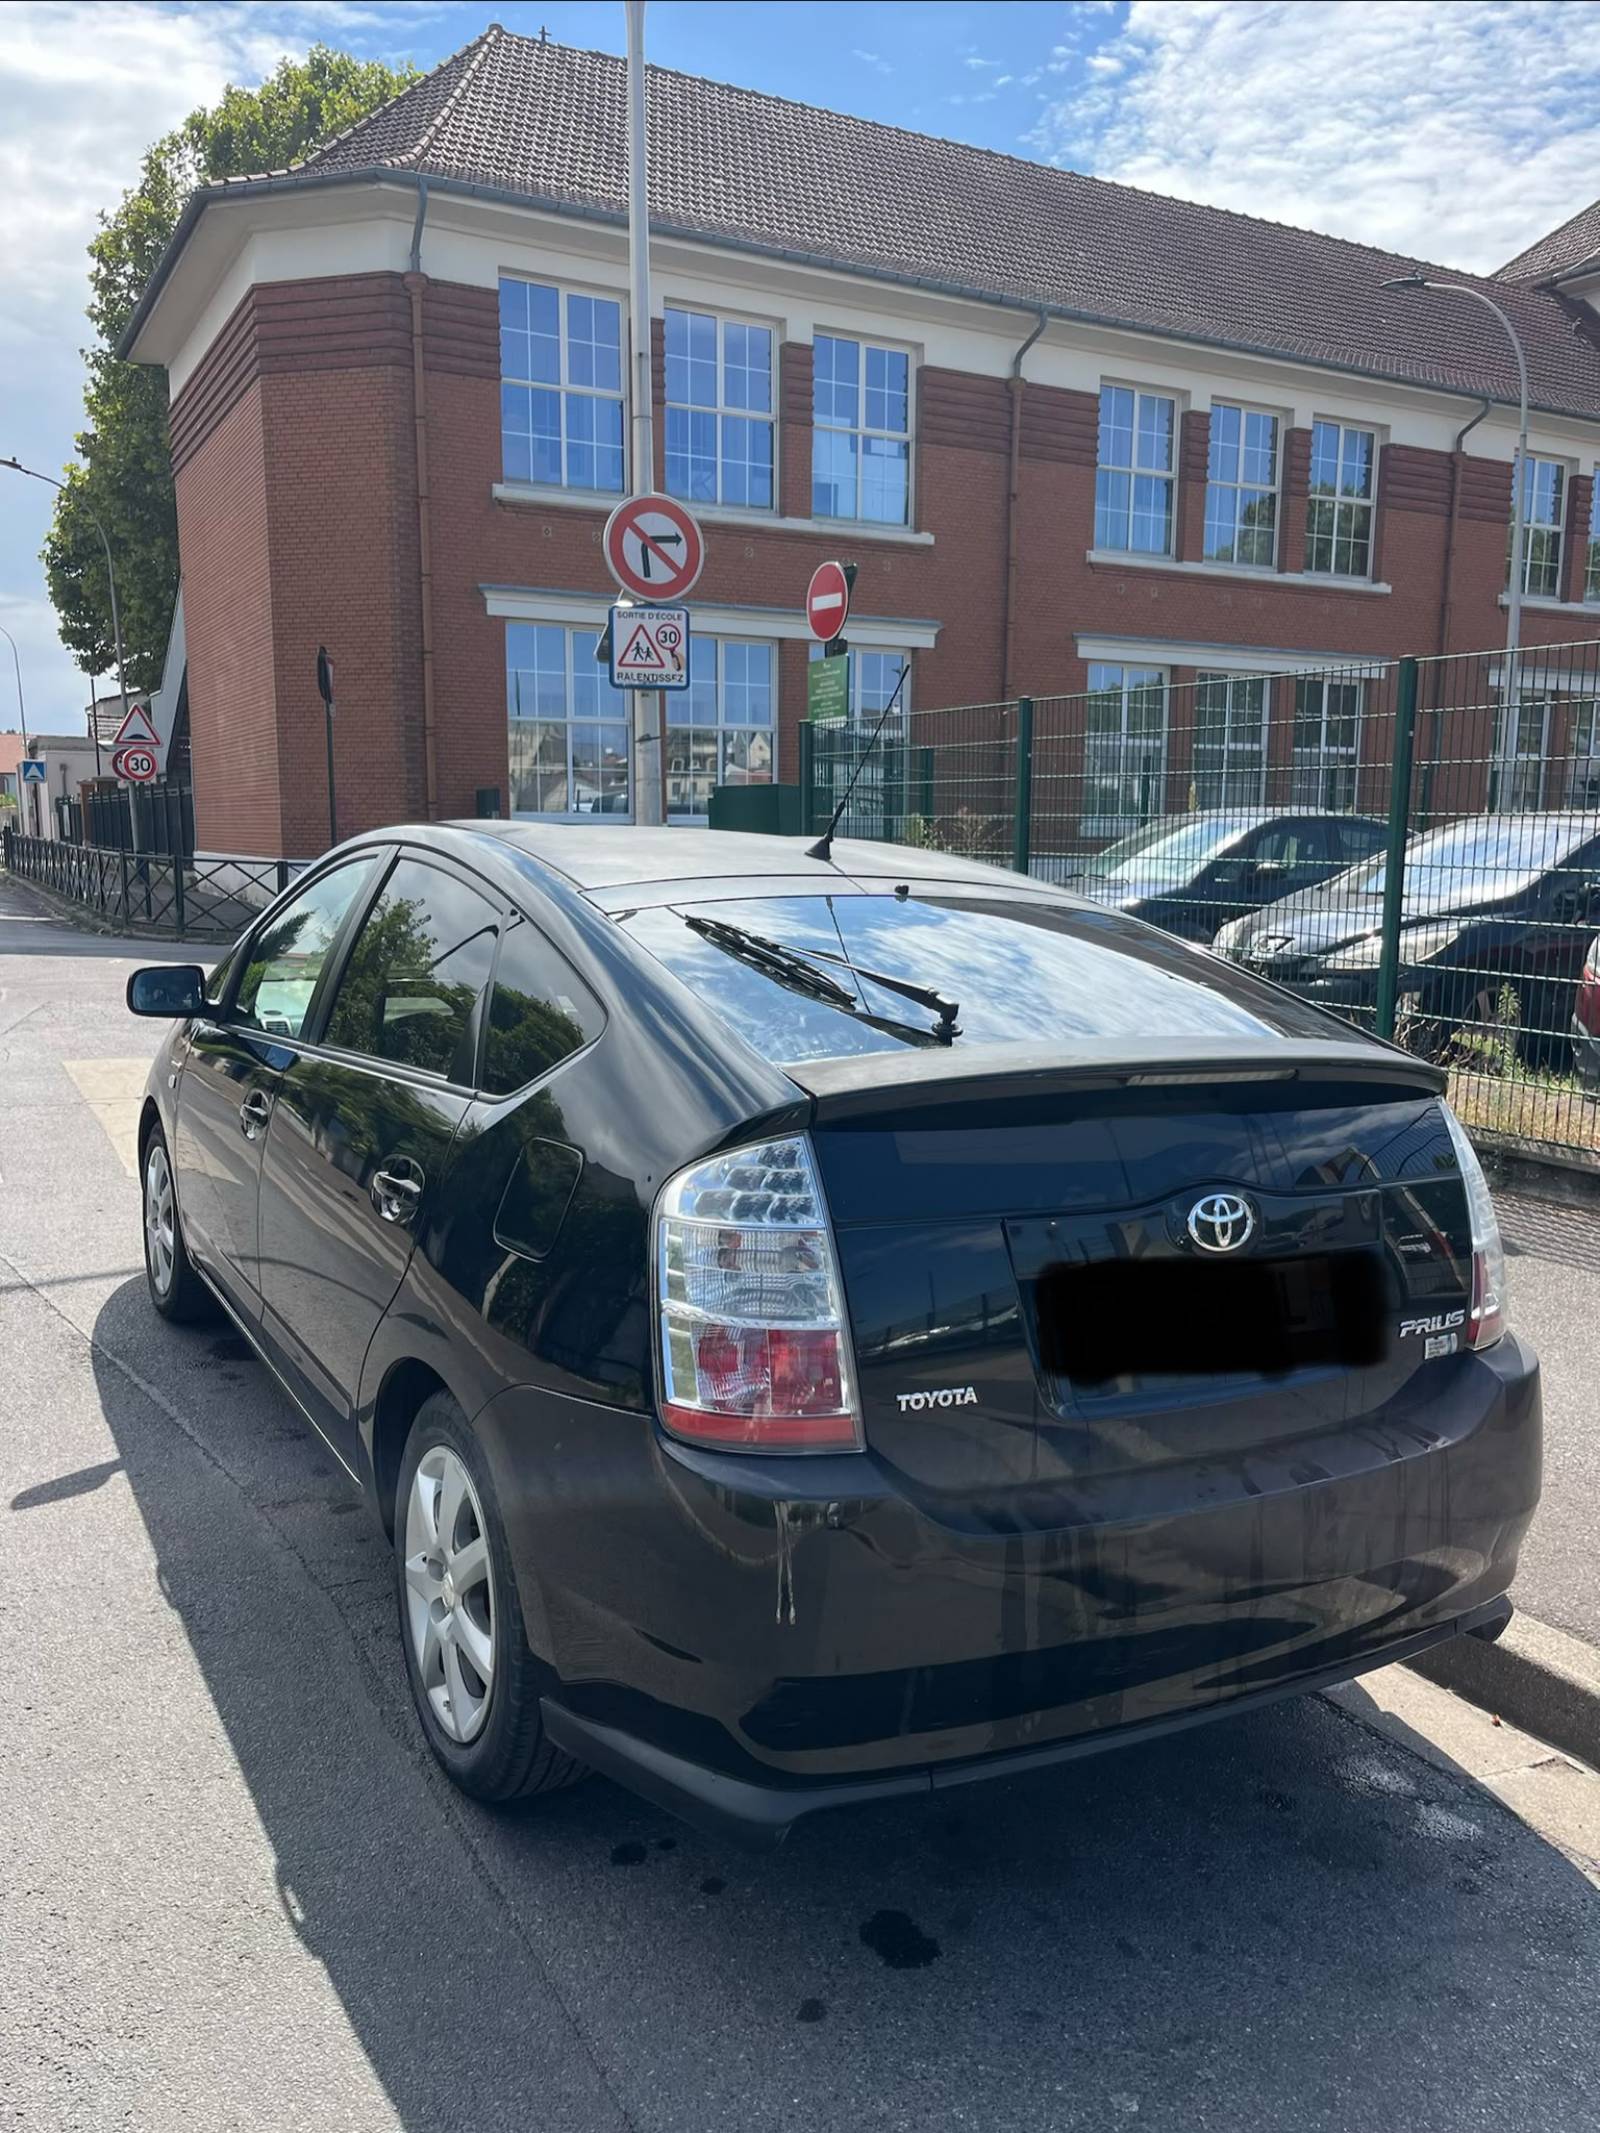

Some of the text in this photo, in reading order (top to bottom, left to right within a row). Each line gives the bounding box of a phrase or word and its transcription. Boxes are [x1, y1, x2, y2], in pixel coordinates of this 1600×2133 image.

[617, 611, 646, 620] SORTIE
[660, 631, 678, 644] 30
[130, 757, 150, 772] 30
[1400, 1310, 1465, 1337] PRIUS
[896, 1386, 978, 1412] TOYOTA
